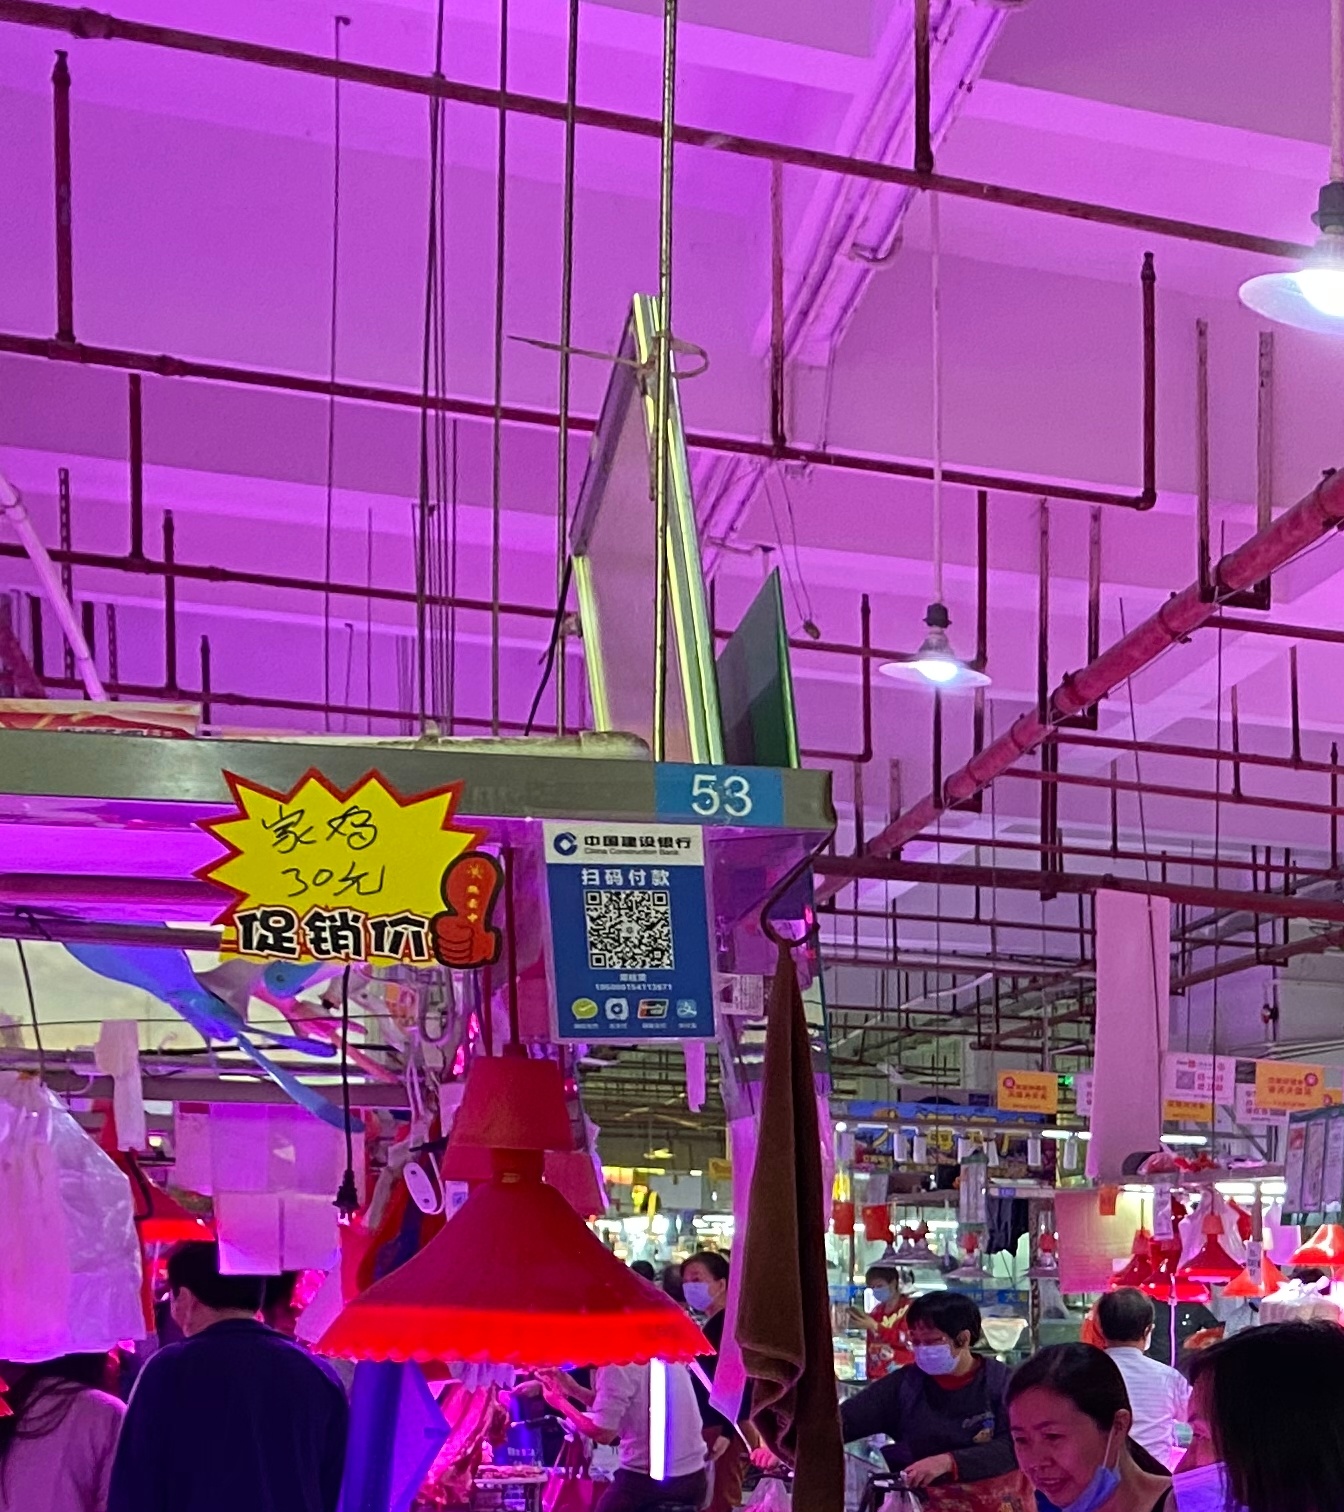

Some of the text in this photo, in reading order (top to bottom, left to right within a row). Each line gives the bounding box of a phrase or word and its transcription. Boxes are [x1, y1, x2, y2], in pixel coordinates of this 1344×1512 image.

[691, 774, 753, 817] 53
[584, 835, 692, 850] 中国建设银行
[281, 861, 386, 898] 30元
[581, 867, 671, 887] 扫码付款
[234, 905, 430, 961] 促销价
